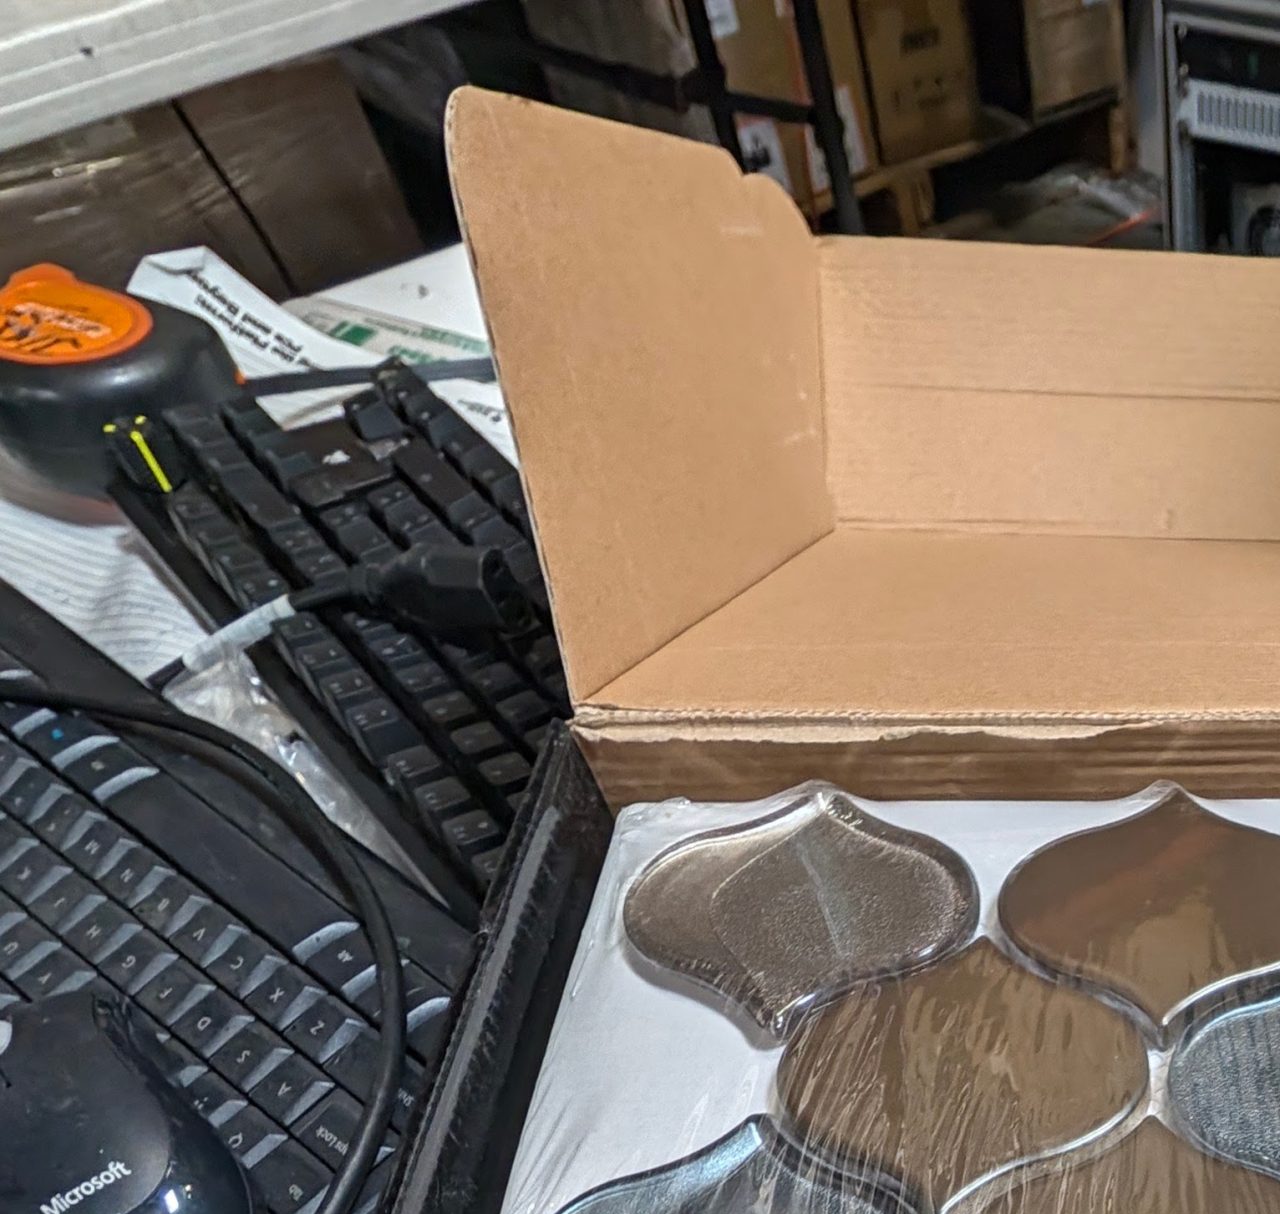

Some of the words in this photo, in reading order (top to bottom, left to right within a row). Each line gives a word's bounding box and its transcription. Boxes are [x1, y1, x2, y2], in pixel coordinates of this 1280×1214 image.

[272, 987, 286, 1003] X
[196, 1016, 212, 1031] D
[309, 1020, 326, 1036] Z
[235, 1049, 251, 1064] S
[276, 1082, 293, 1097] A
